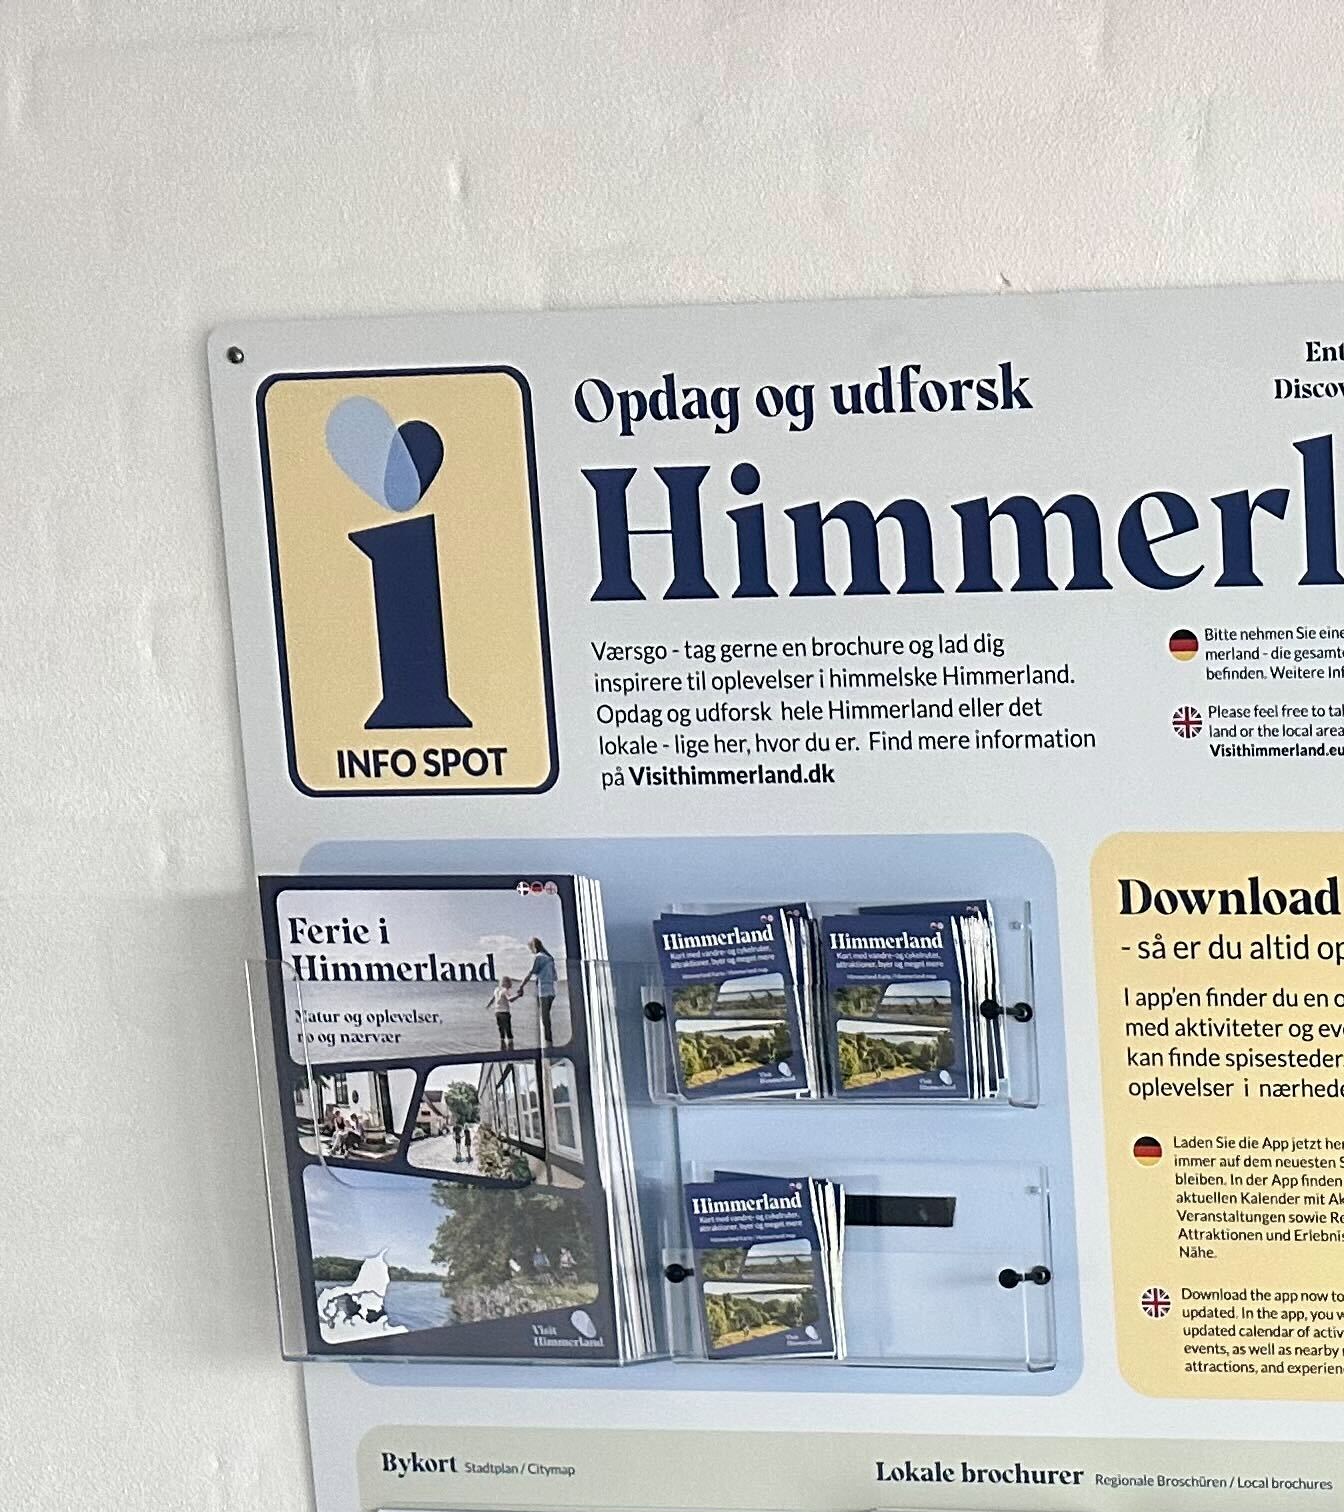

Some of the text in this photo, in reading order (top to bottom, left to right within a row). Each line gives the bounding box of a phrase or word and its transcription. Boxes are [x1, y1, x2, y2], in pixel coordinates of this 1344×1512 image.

[574, 361, 1033, 436] Opdag og udforsk
[594, 663, 1074, 696] inspirere til oplevelser i himmelske Himmerland.
[1206, 665, 1267, 680] befinden.
[1269, 665, 1324, 679] Weitere
[1209, 742, 1344, 757] Visithimmerland.eu
[336, 747, 507, 778] INFO SPOT
[601, 763, 835, 790] på Visithimmerland.dk
[1117, 875, 1341, 915] Download
[288, 917, 390, 944] Ferie i
[662, 924, 774, 951] Himmerland
[830, 932, 943, 950] Himmerland
[1138, 940, 1166, 959] så
[1173, 940, 1201, 959] er
[1208, 933, 1241, 959] du
[1250, 933, 1309, 960] altid
[292, 953, 497, 983] Himmerland
[1124, 987, 1128, 1006] I
[1135, 986, 1200, 1010] app'en
[1205, 986, 1267, 1007] finder
[1272, 987, 1298, 1007] du
[1303, 992, 1328, 1007] en
[344, 1011, 362, 1027] og
[366, 1008, 443, 1025] oplevelser,
[318, 1032, 336, 1047] og
[340, 1031, 402, 1044] nærvær
[692, 1192, 802, 1214] Himmerland
[1176, 1209, 1285, 1225] Veranstaltungen
[1288, 1211, 1327, 1224] sowie
[1184, 1360, 1258, 1375] attractions,
[1260, 1360, 1284, 1373] and
[381, 1451, 457, 1478] Bykort
[464, 1461, 518, 1475] Stadtplan
[527, 1462, 575, 1477] Citymap
[875, 1460, 1084, 1485] Lokale brochurer
[1095, 1473, 1154, 1488] Regionale
[1157, 1474, 1227, 1488] Broschüren
[1237, 1476, 1268, 1489] Local
[1271, 1476, 1333, 1490] brochures
